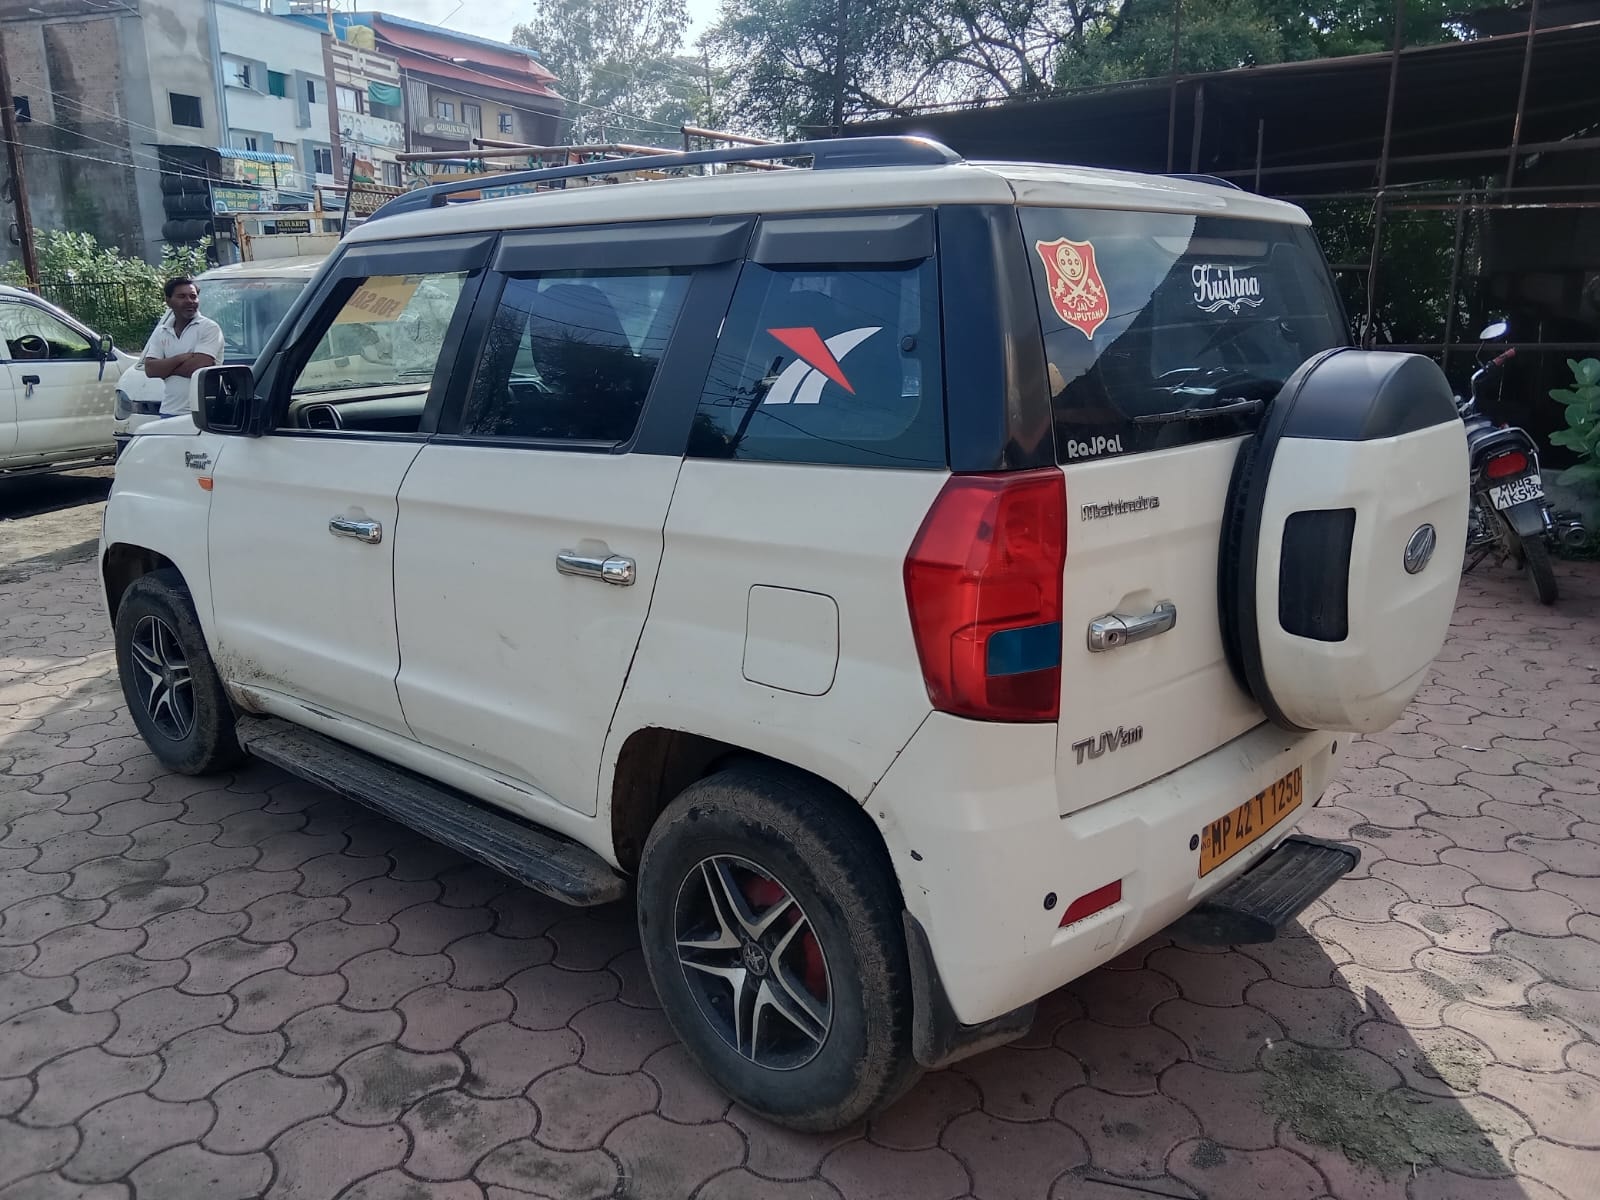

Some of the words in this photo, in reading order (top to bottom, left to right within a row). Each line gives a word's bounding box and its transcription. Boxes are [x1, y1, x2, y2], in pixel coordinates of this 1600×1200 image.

[1081, 496, 1160, 521] Mahindra
[1211, 815, 1231, 858] MP
[1235, 800, 1253, 839] 42
[1255, 792, 1267, 825] T
[1271, 766, 1300, 816] 1250
